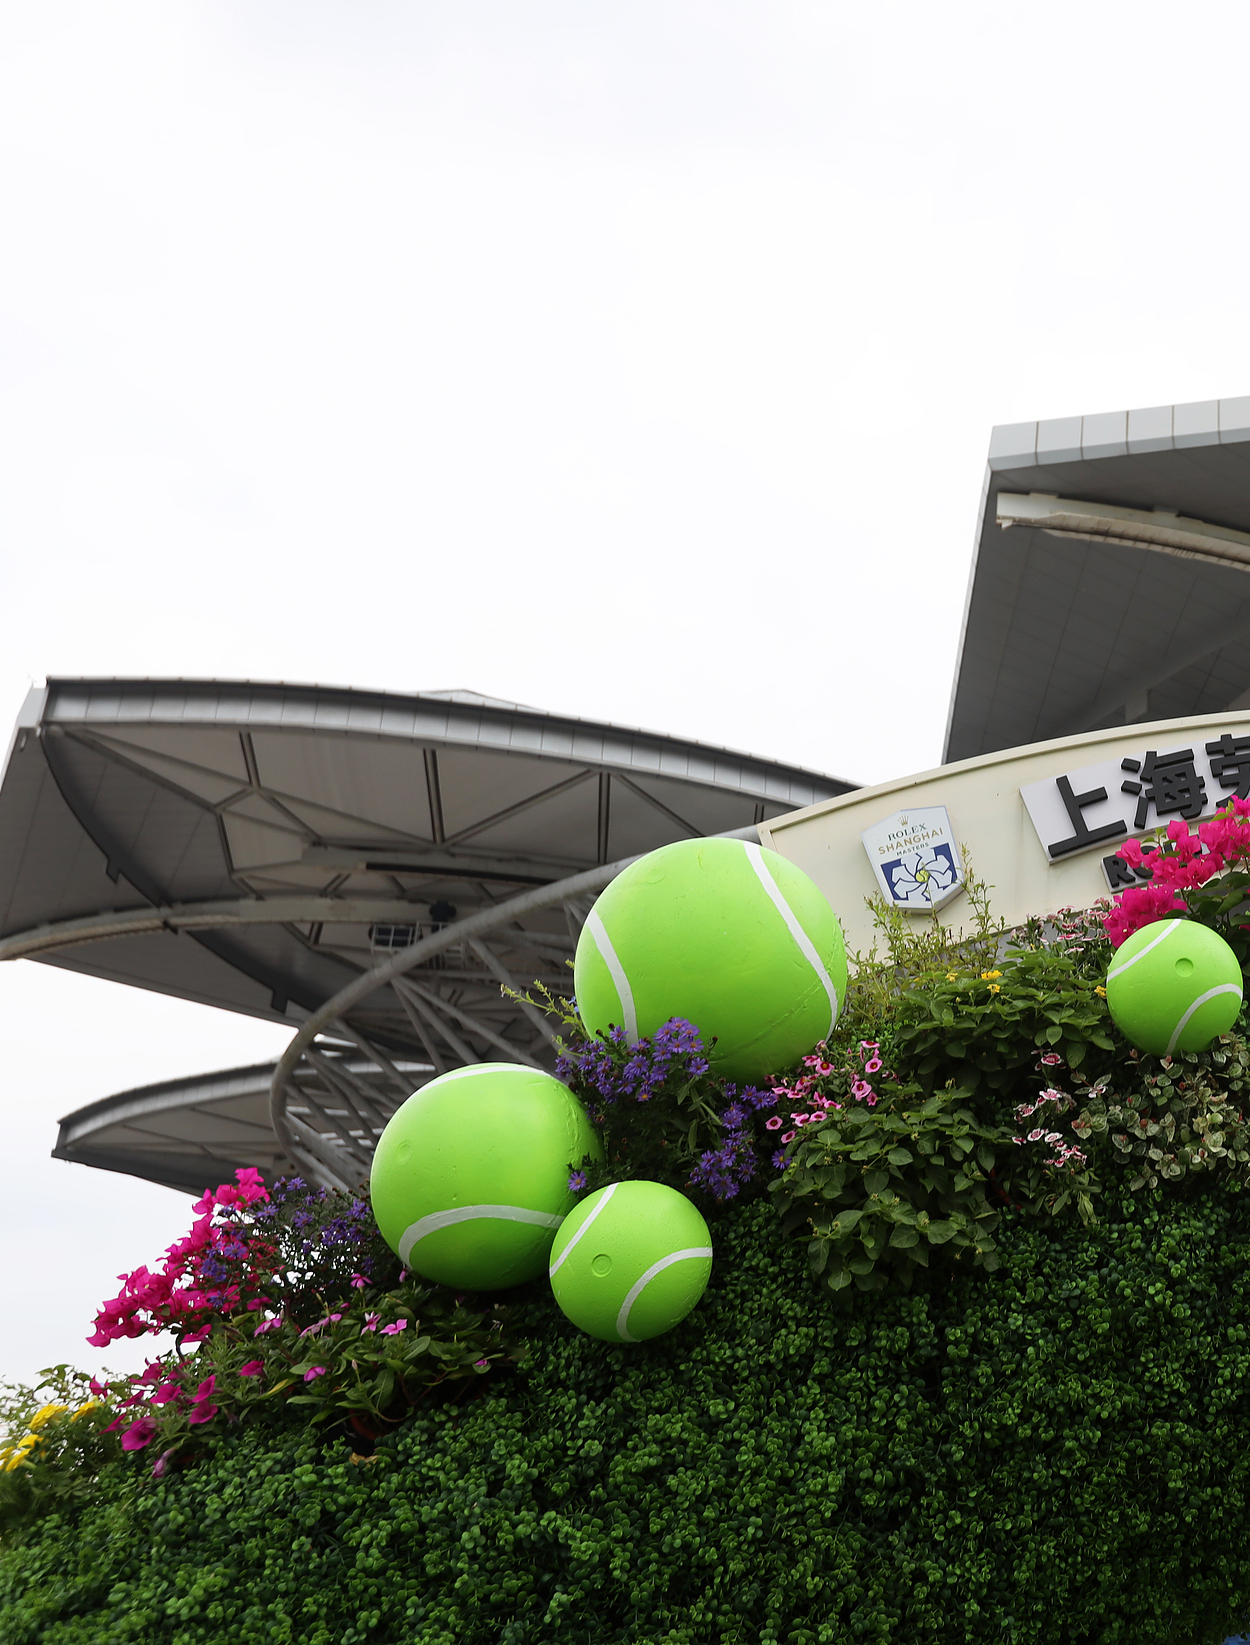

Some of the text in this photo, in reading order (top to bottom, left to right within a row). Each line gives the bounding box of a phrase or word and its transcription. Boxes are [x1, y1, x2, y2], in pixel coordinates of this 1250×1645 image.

[878, 827, 944, 855] SHANGHAI
[888, 823, 927, 841] ROLEX
[896, 842, 929, 857] MASTERS
